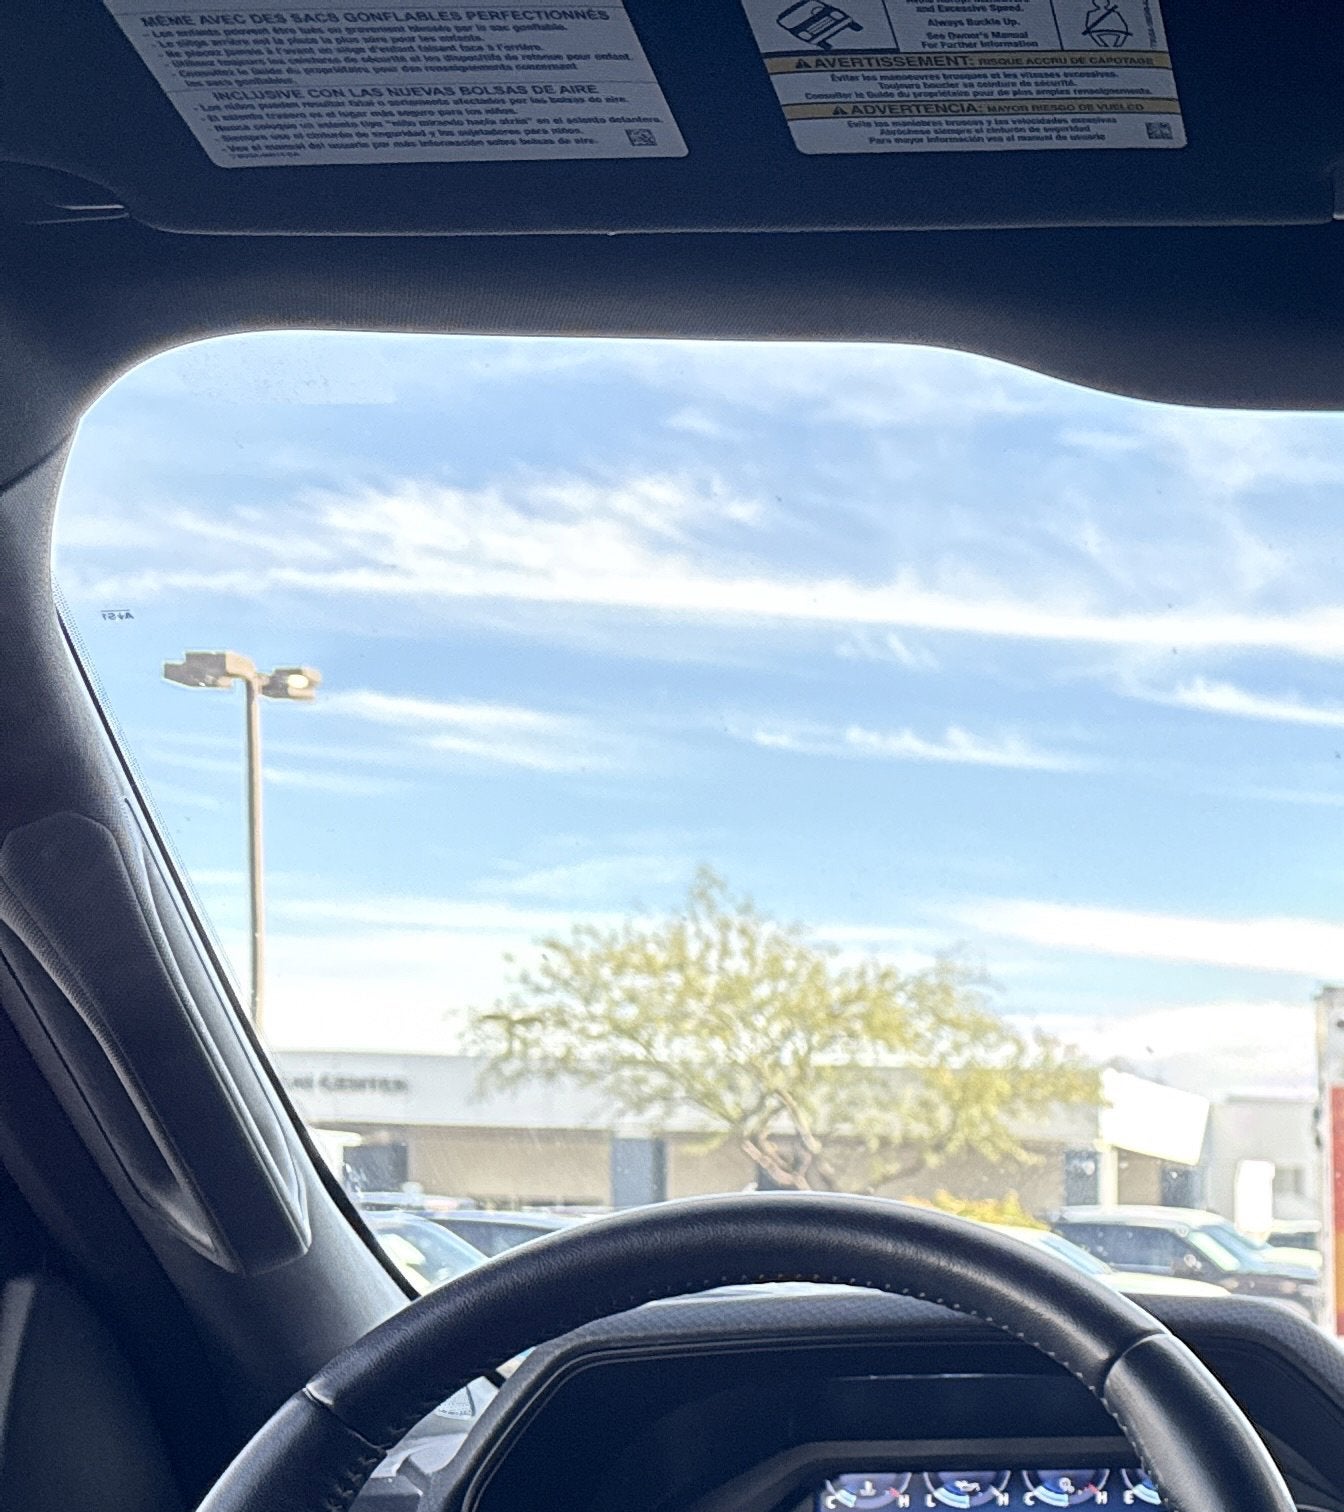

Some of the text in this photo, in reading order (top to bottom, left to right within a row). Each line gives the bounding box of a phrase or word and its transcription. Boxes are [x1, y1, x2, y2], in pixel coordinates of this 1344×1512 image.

[200, 13, 246, 25] AVEC
[251, 13, 287, 24] DES
[293, 12, 339, 23] SACS
[815, 56, 974, 69] AVERTISSEMENT:
[213, 85, 599, 101] INCLUSIVE CON LAS NUEVAS BOLSAS DE AIRE
[851, 103, 982, 115] ADVERTENCIA:
[825, 1494, 837, 1510] C
[898, 1493, 910, 1508] H
[926, 1494, 936, 1508] L
[997, 1493, 1009, 1507] H
[1024, 1492, 1036, 1507] C
[1096, 1491, 1108, 1505] H
[1124, 1492, 1134, 1505] E
